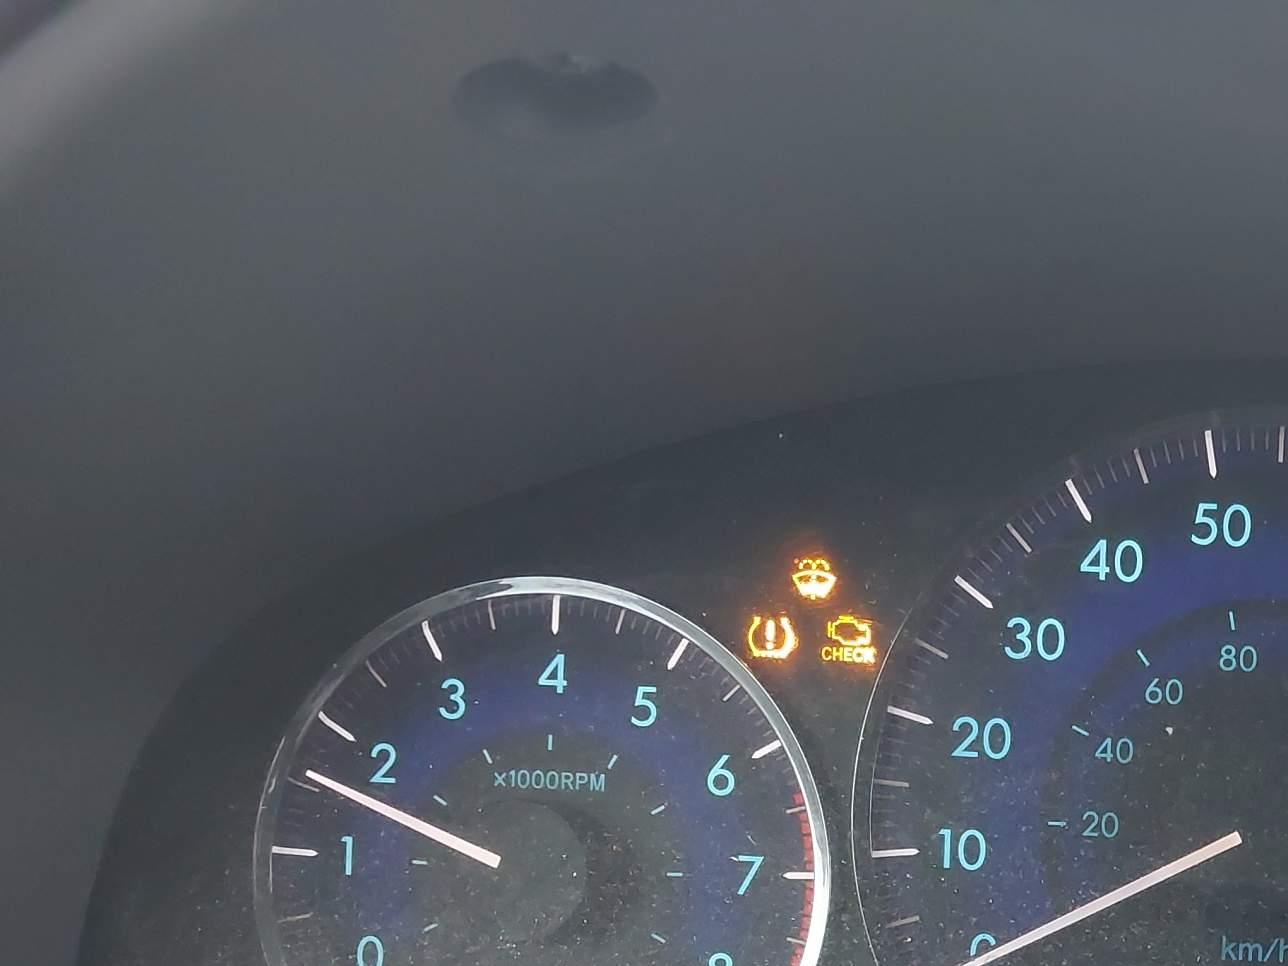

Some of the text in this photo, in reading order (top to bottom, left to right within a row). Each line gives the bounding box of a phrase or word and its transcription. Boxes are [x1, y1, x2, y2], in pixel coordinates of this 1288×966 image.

[1191, 503, 1251, 547] 50
[1080, 539, 1143, 582] 40
[821, 646, 877, 665] CHECK
[1004, 617, 1065, 661] 30
[1219, 645, 1257, 672] 80
[538, 653, 568, 694] 4
[1145, 678, 1183, 705] 60
[438, 678, 466, 720] 3
[631, 686, 658, 727] 5
[951, 716, 1011, 759] 20
[1095, 737, 1133, 764] 40
[369, 743, 397, 784] 2
[706, 754, 736, 797] 6
[1082, 811, 1119, 838] 20
[340, 836, 353, 875] 1
[938, 828, 987, 871] 10
[737, 855, 765, 896] 7
